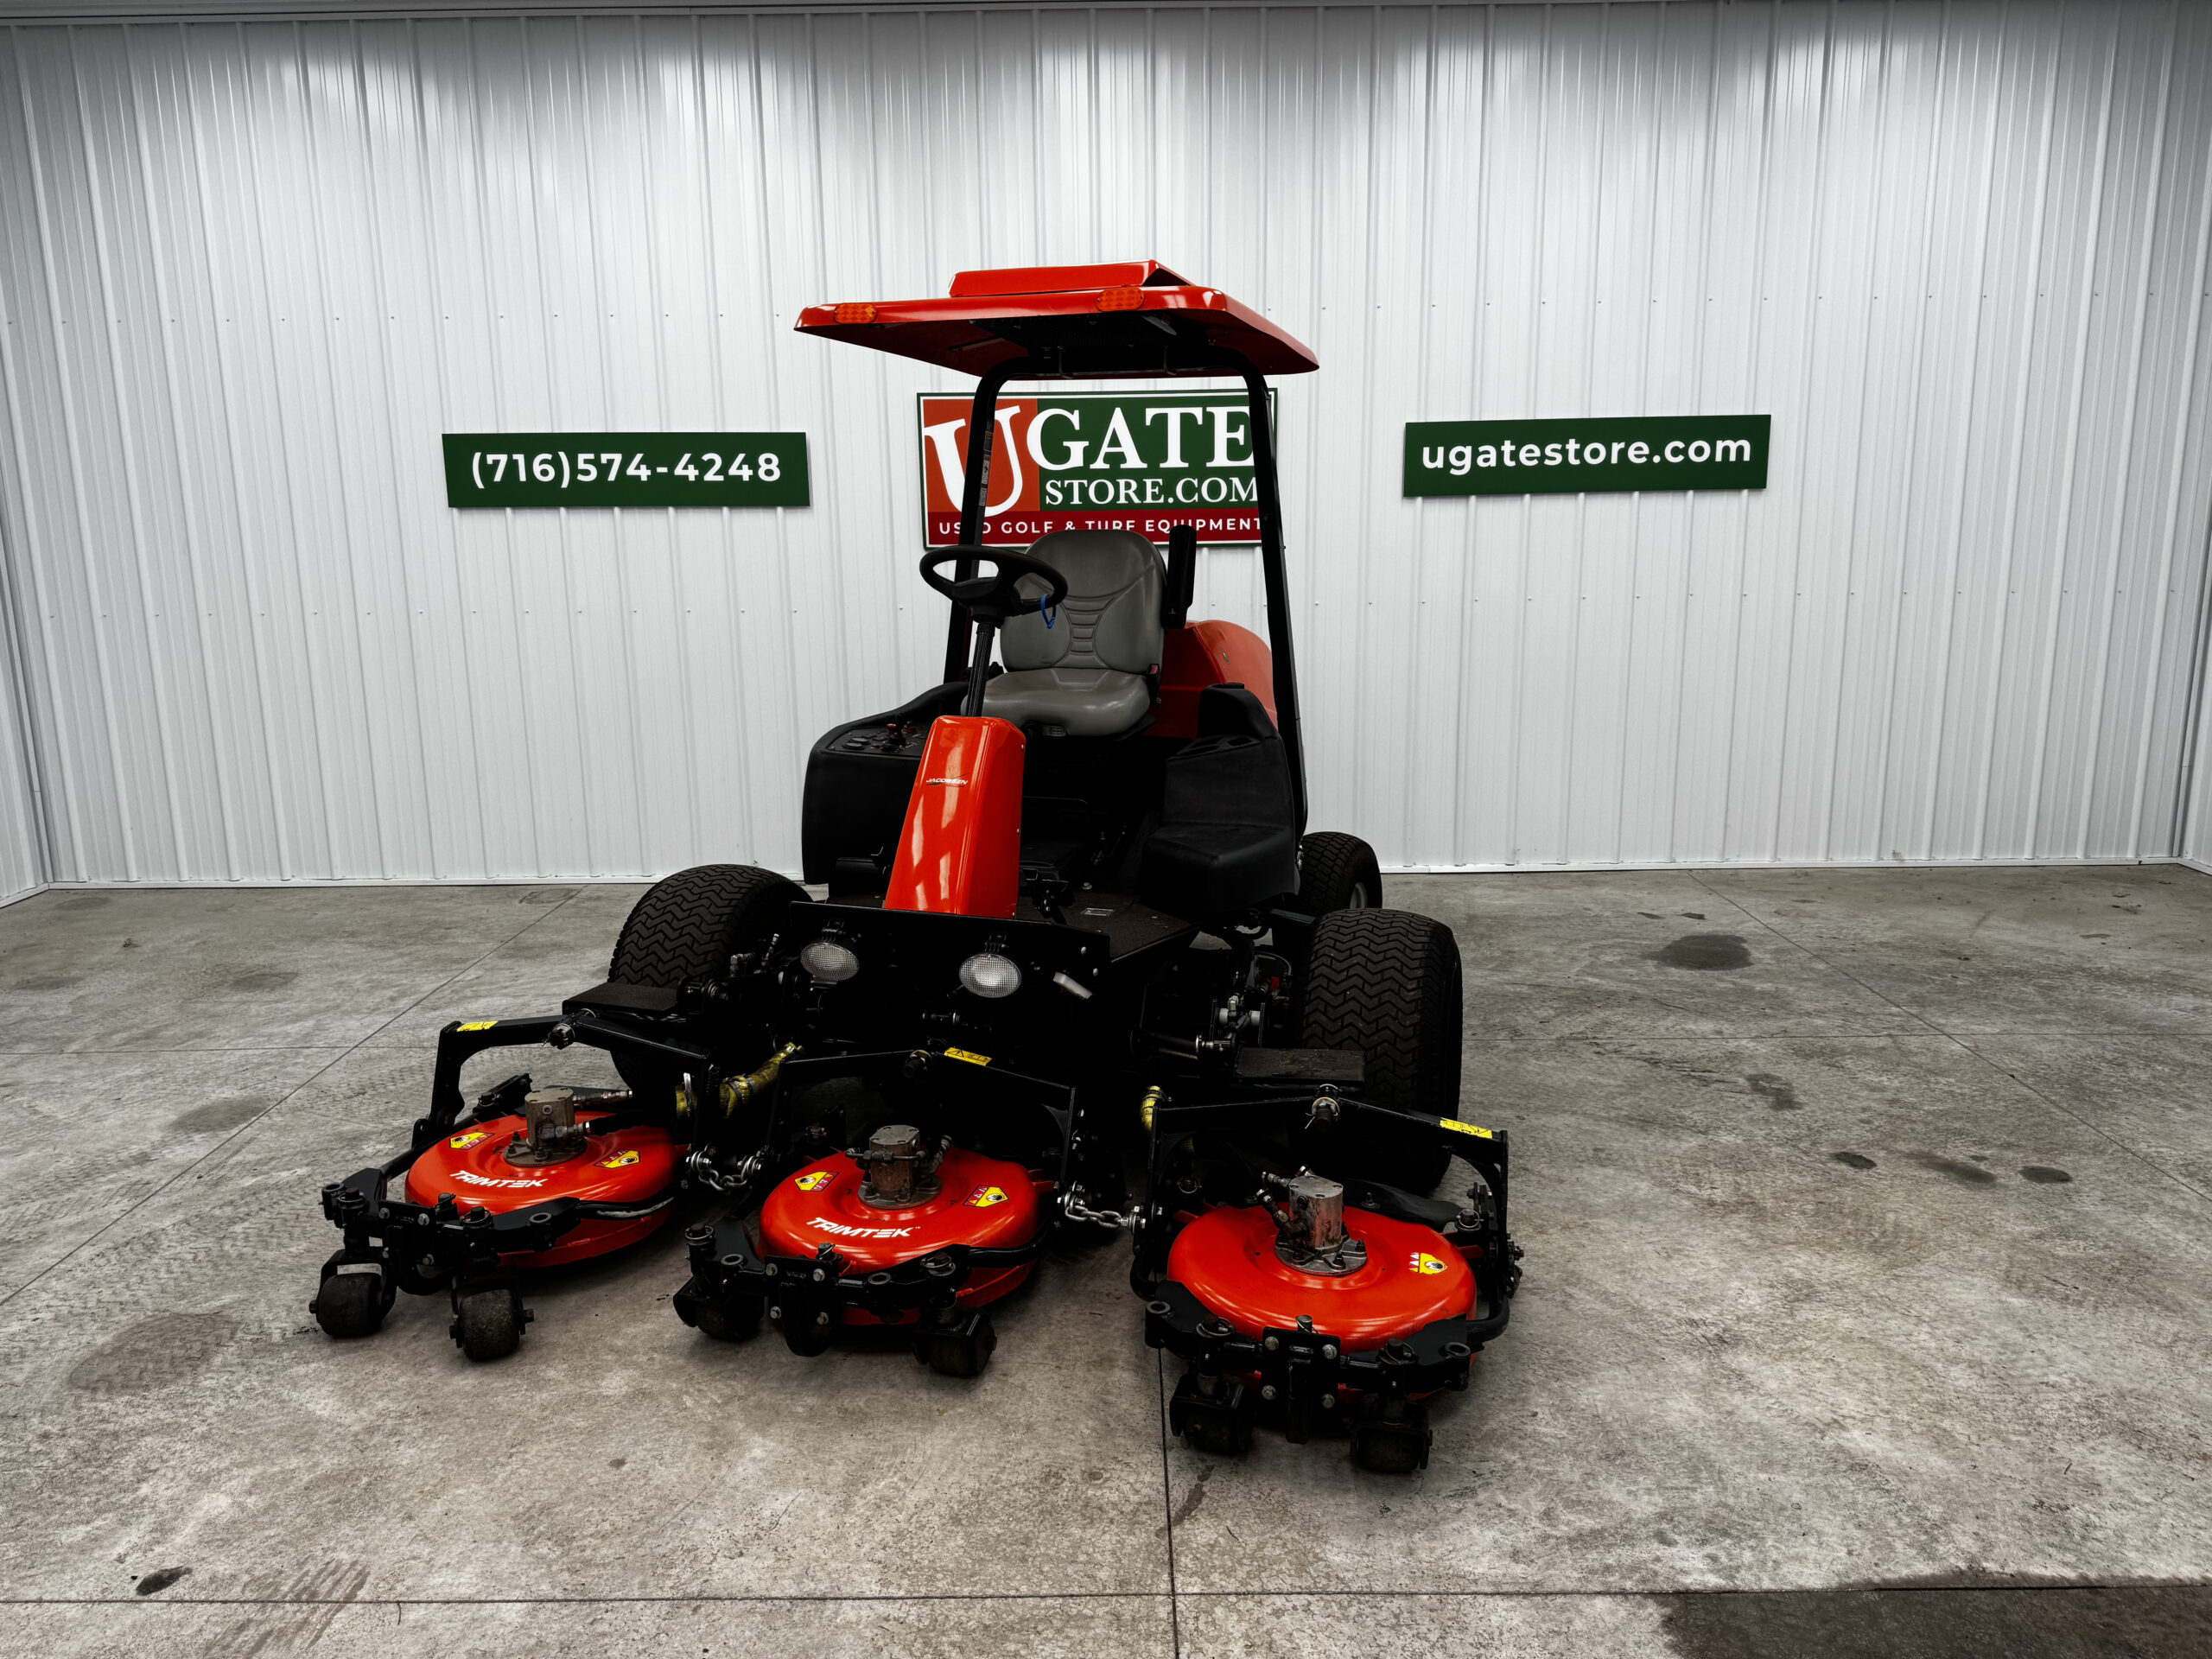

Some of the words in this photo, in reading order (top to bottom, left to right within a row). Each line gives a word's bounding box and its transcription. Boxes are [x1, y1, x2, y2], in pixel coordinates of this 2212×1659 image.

[1421, 438, 1751, 475] ugatestore.com
[472, 451, 782, 489] (716)574-4248
[1045, 477, 1258, 505] STORE.COM
[939, 522, 991, 534] USD
[1001, 521, 1053, 534] GOLF
[1065, 520, 1076, 531] &
[449, 1169, 549, 1188] TRIMTEK
[805, 1217, 914, 1238] TRIMTEK
